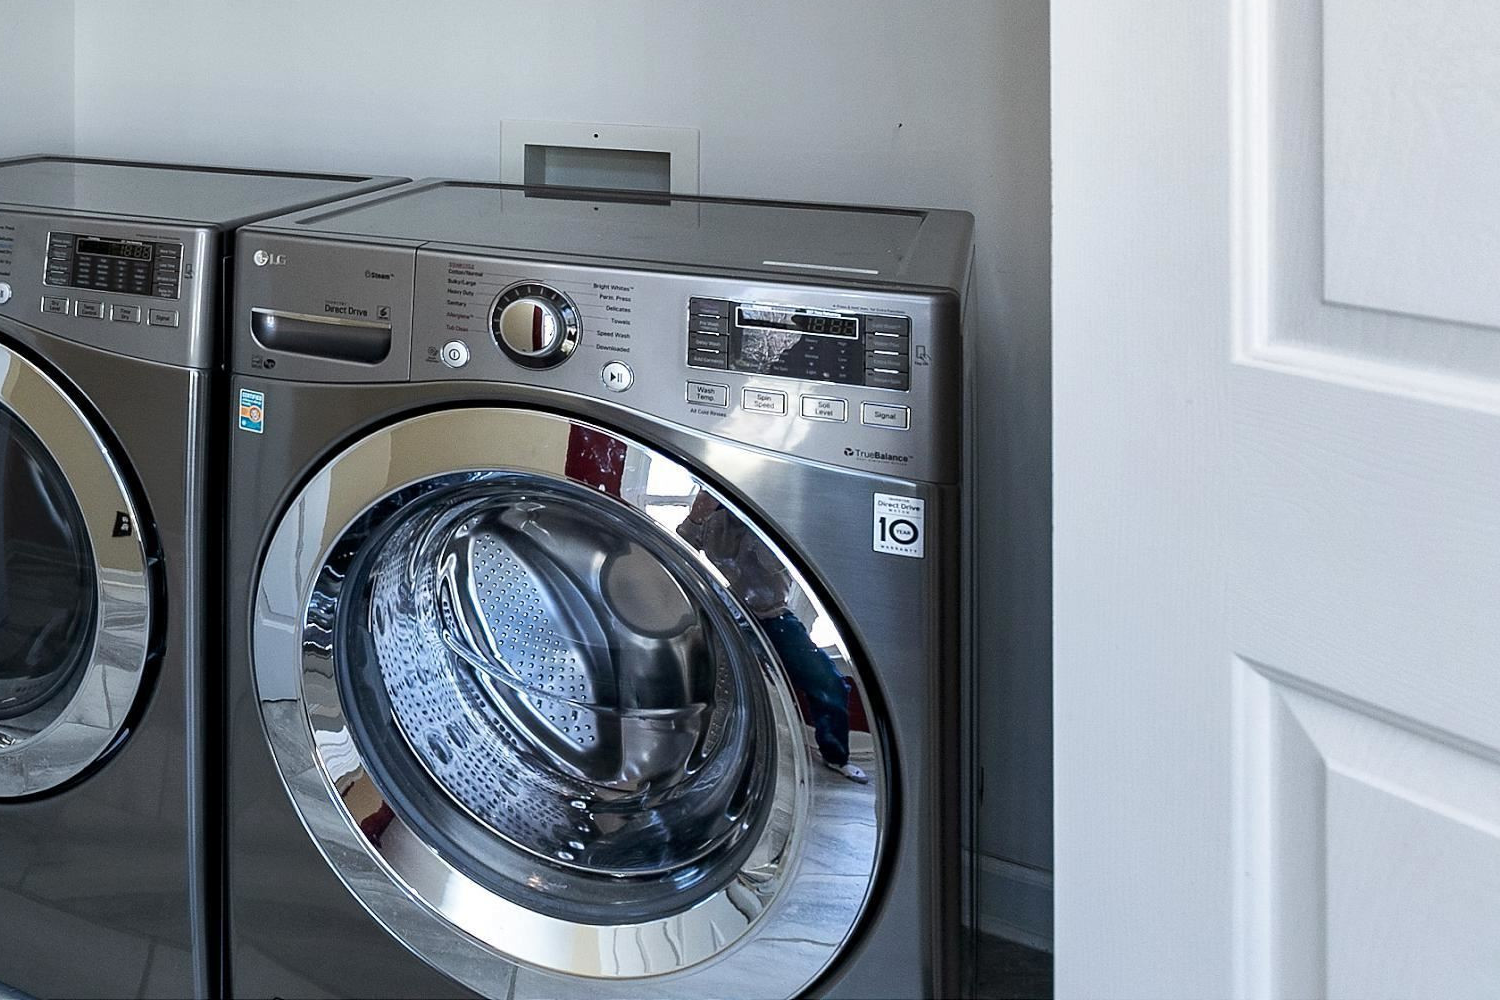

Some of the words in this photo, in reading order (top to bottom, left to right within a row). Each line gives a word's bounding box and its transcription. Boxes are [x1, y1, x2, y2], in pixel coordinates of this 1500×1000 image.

[269, 254, 287, 265] LG
[371, 271, 391, 280] Steam
[324, 304, 347, 315] Direct
[348, 306, 368, 317] Drive
[606, 305, 631, 313] Delicates
[155, 314, 172, 322] Signal
[597, 330, 614, 338] Speed
[596, 344, 630, 353] Downloaded
[697, 386, 715, 394] Wash
[754, 401, 774, 409] Speed
[815, 408, 833, 416] Level
[874, 411, 896, 420] Signal
[855, 449, 908, 462] TrueBalance
[878, 500, 899, 508] Direct
[901, 503, 920, 511] Drive
[879, 517, 919, 545] 10
[881, 545, 917, 553] WARRANTY
